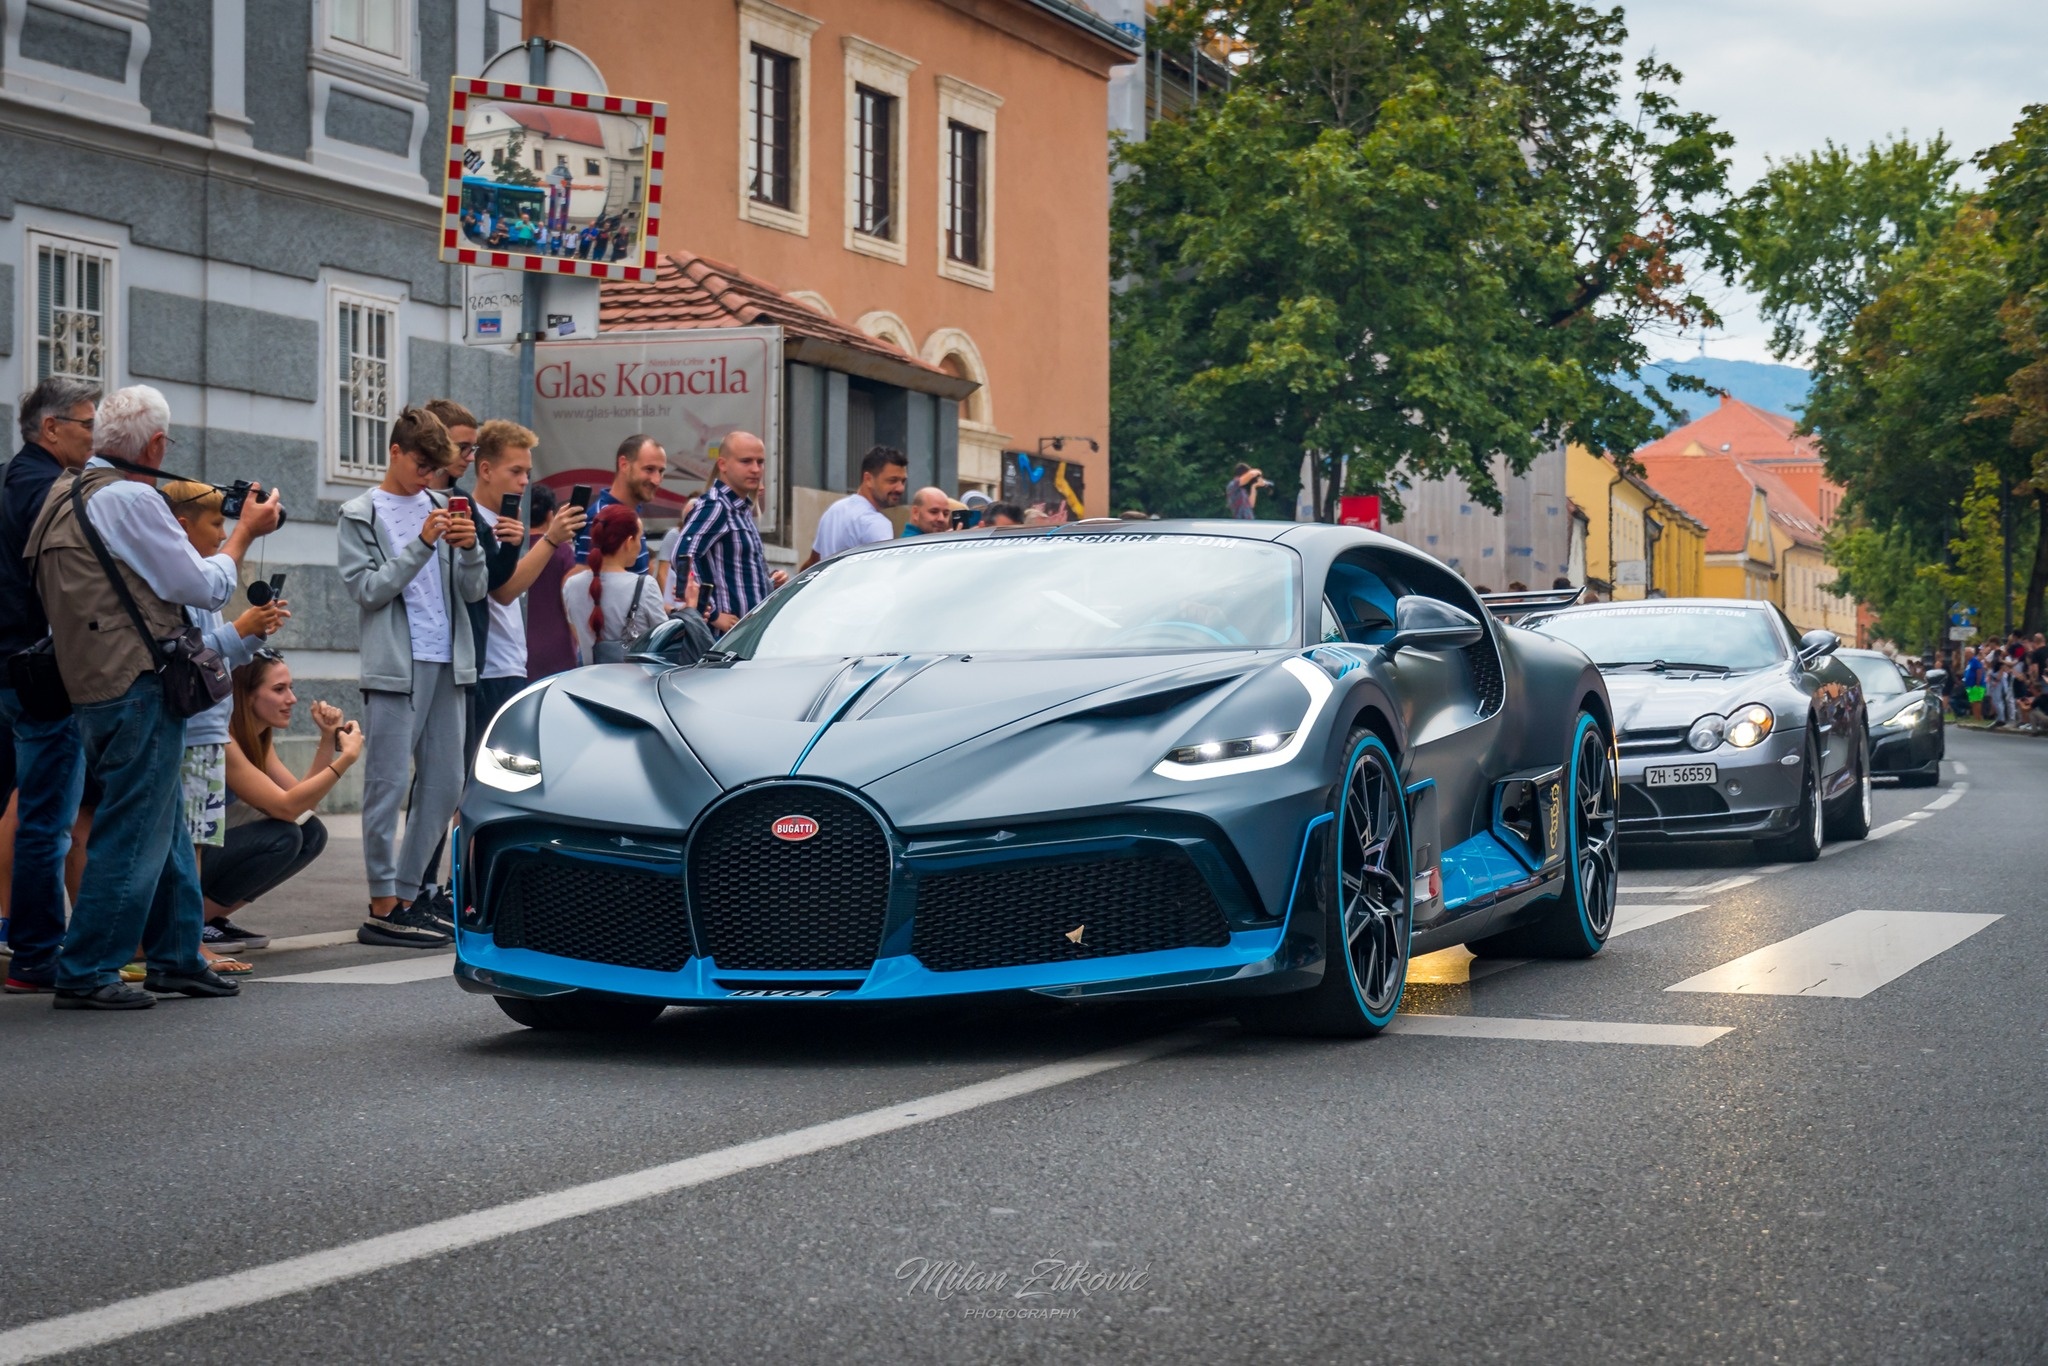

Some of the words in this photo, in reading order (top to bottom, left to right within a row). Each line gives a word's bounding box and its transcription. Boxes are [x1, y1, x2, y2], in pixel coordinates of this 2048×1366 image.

[535, 360, 607, 399] Glas
[614, 356, 750, 397] Koncila
[552, 404, 671, 422] www.glas-koncila.hr
[847, 534, 1239, 563] SUPERCAROWNERSCIRCLE.COM
[777, 823, 813, 833] BUGATTI
